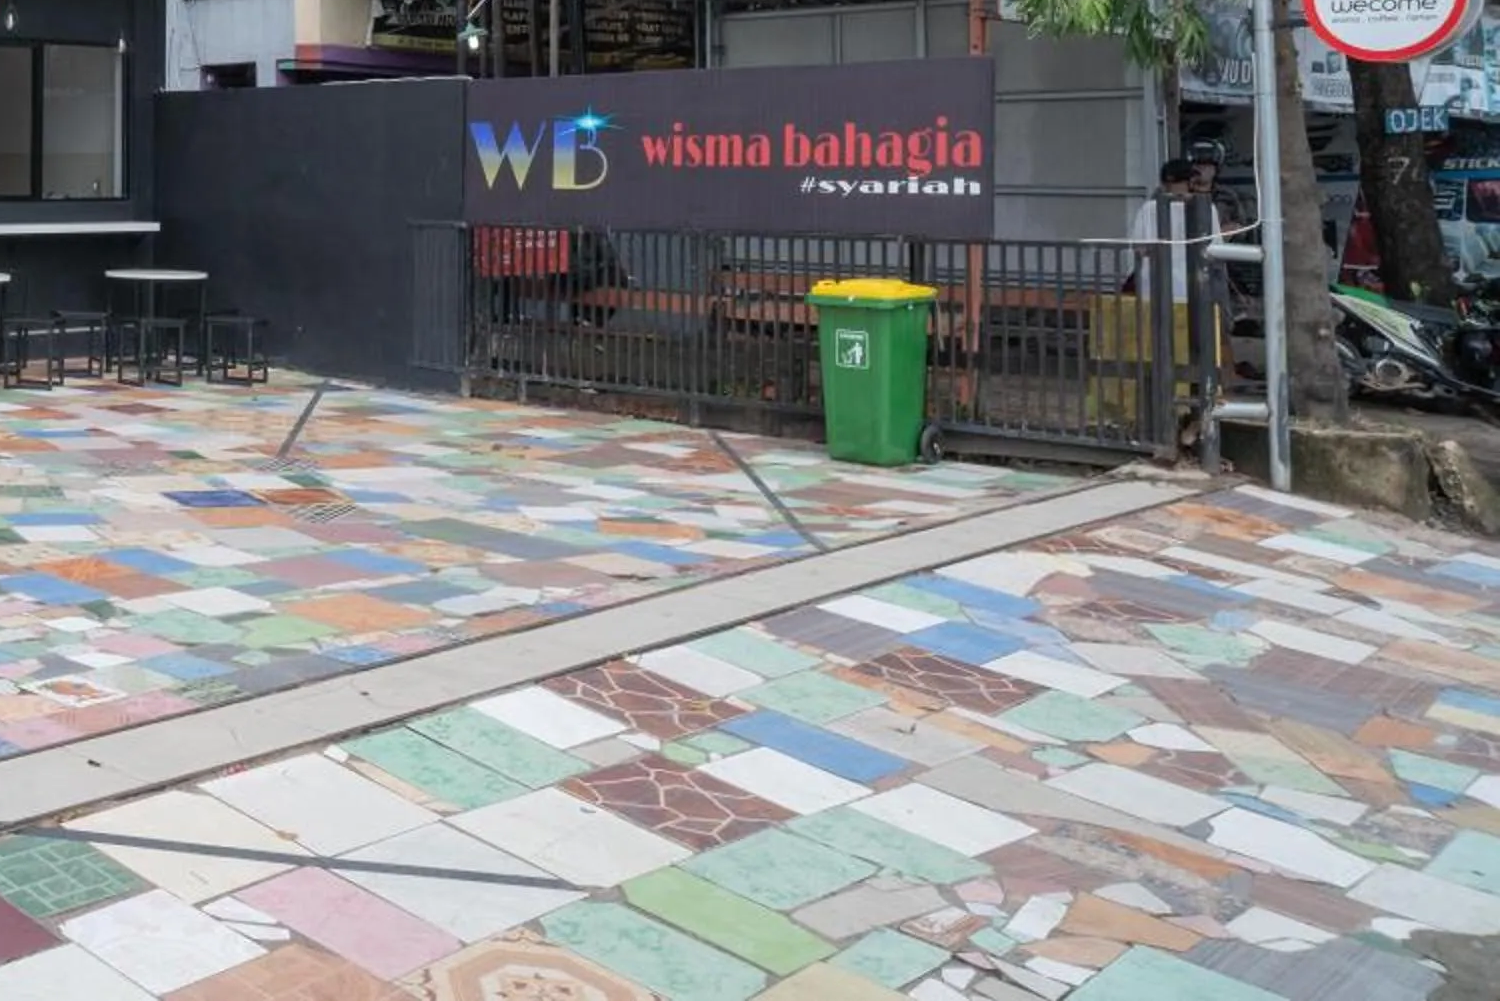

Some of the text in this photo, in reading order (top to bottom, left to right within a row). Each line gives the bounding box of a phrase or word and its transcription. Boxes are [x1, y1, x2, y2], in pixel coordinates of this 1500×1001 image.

[1391, 107, 1446, 132] OJEK
[469, 120, 607, 190] WB
[641, 116, 983, 176] wisma bahagia
[800, 176, 981, 196] #syariah
